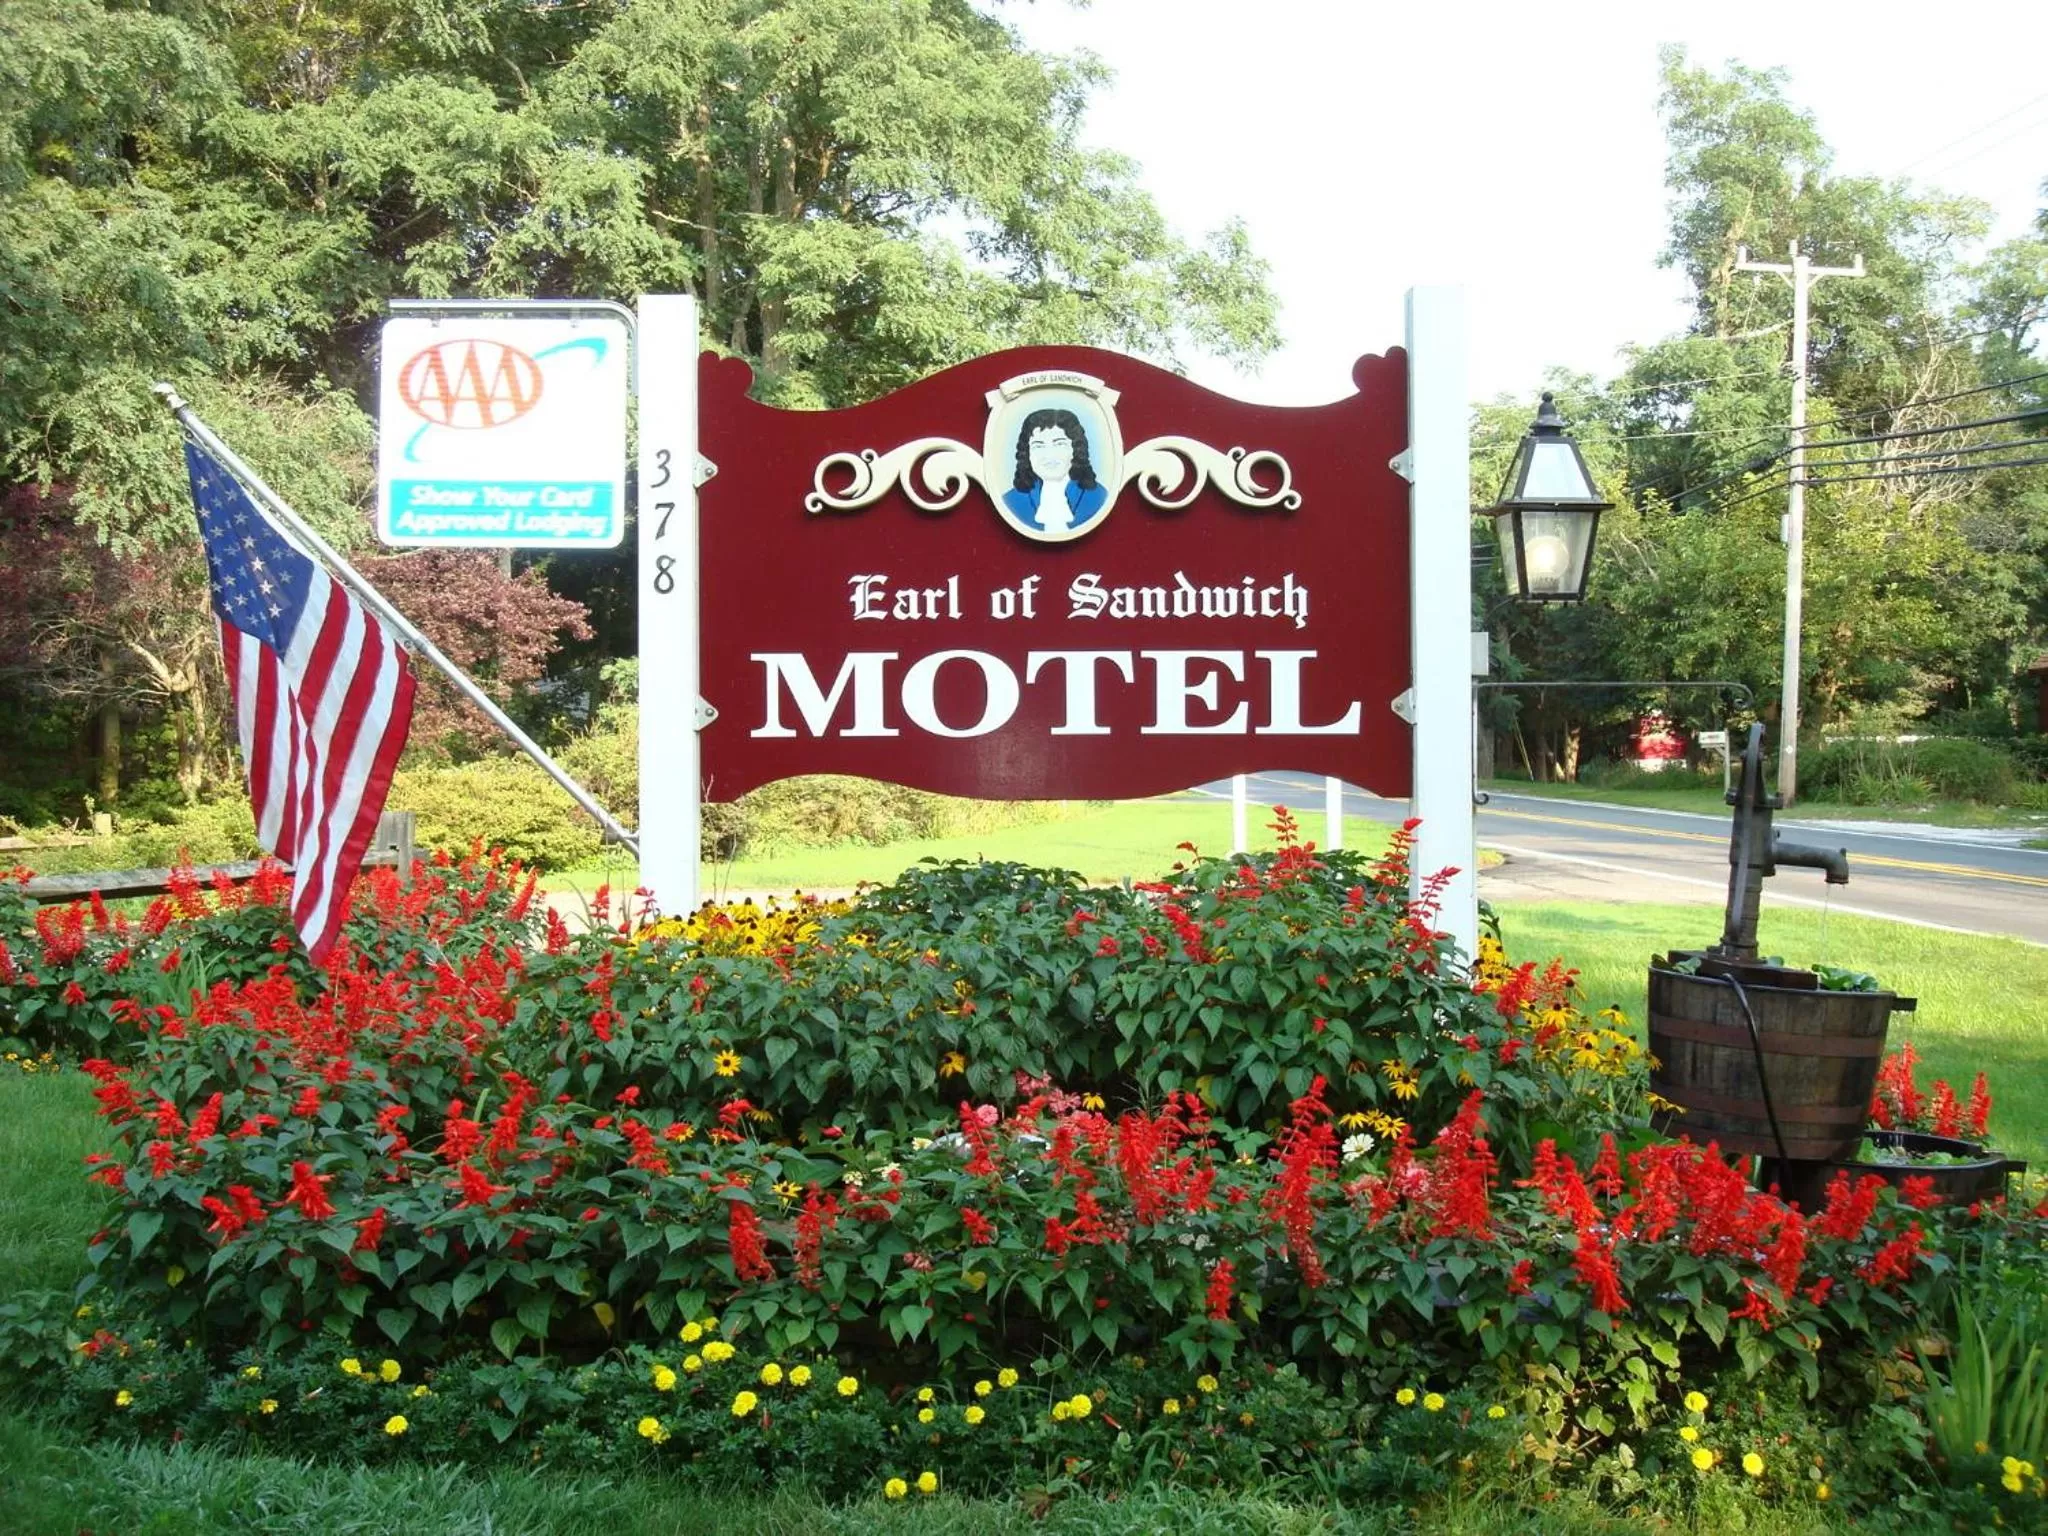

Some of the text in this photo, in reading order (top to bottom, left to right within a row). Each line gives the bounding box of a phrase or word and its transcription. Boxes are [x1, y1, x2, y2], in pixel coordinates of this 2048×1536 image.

[414, 340, 532, 429] AAA
[1022, 373, 1082, 385] EARL OF SANDWICH
[396, 510, 608, 537] Approved Lodging
[410, 485, 595, 507] Show Your Card
[651, 449, 676, 595] 378
[847, 570, 1309, 629] Earl of Sandwich
[750, 649, 1362, 738] MOTEL
